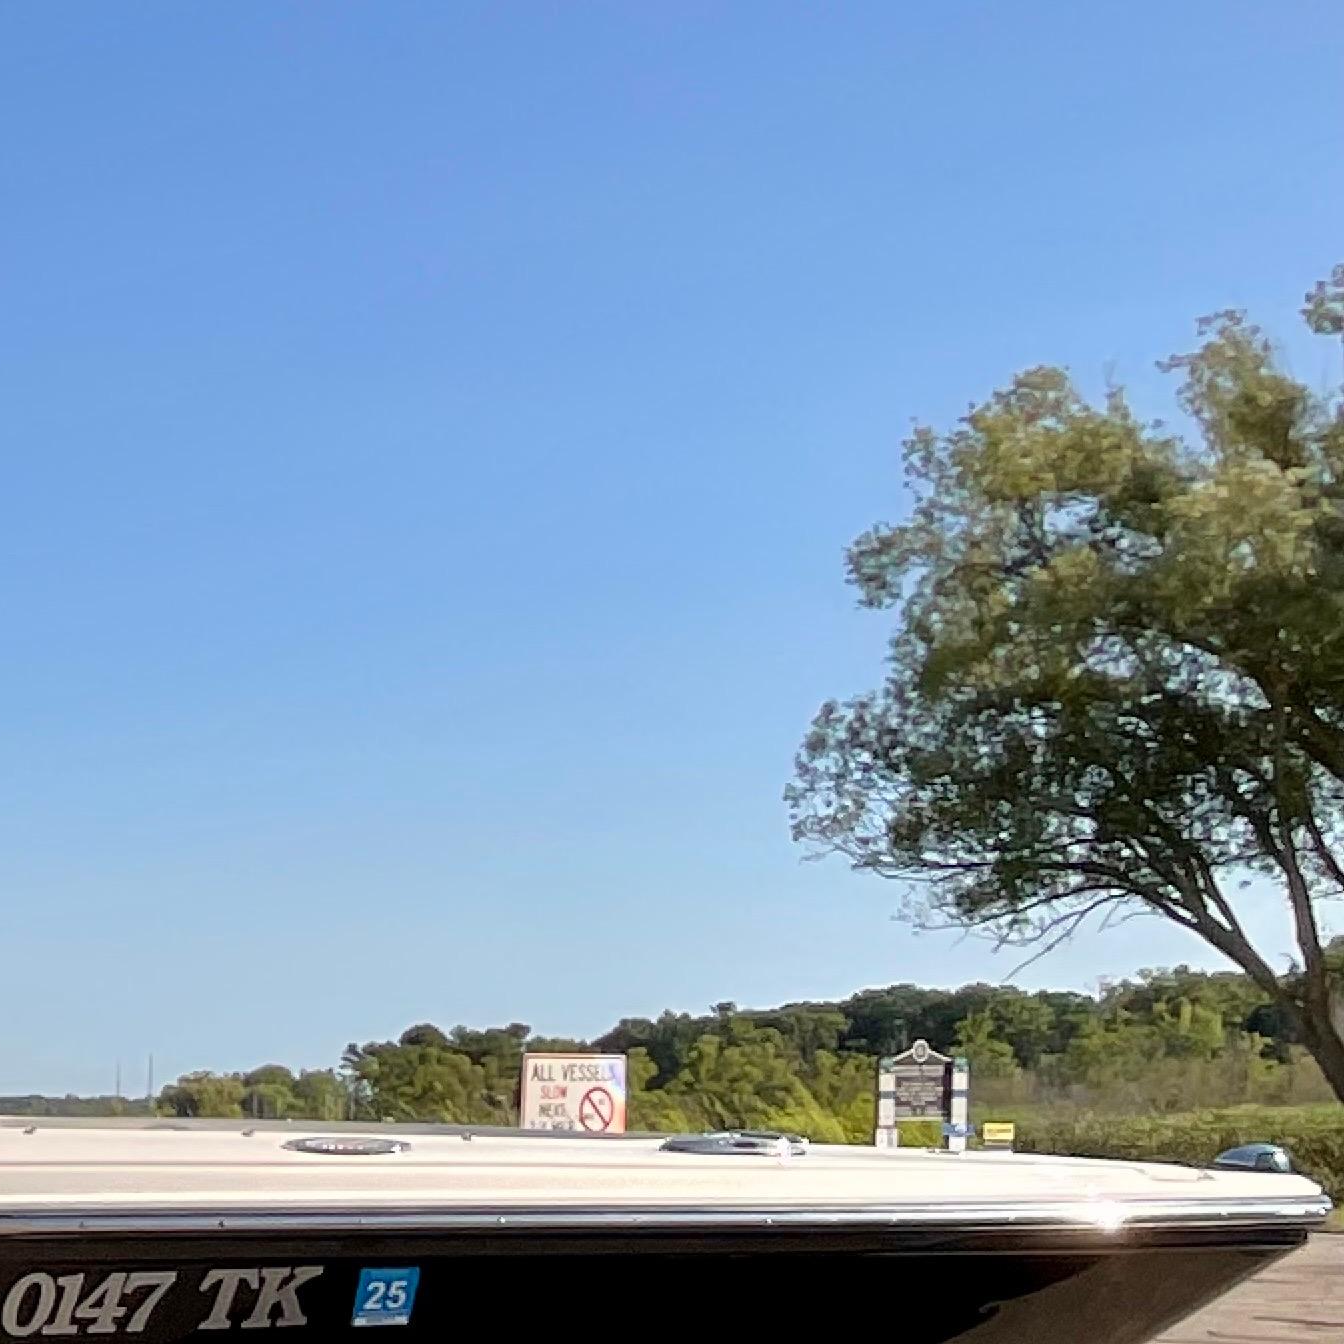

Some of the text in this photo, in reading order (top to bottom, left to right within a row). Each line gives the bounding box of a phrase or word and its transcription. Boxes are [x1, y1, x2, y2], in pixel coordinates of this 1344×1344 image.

[531, 1063, 556, 1082] ALL
[0, 1270, 178, 1338] 0147
[196, 1265, 325, 1330] TK
[363, 1280, 408, 1310] 25
